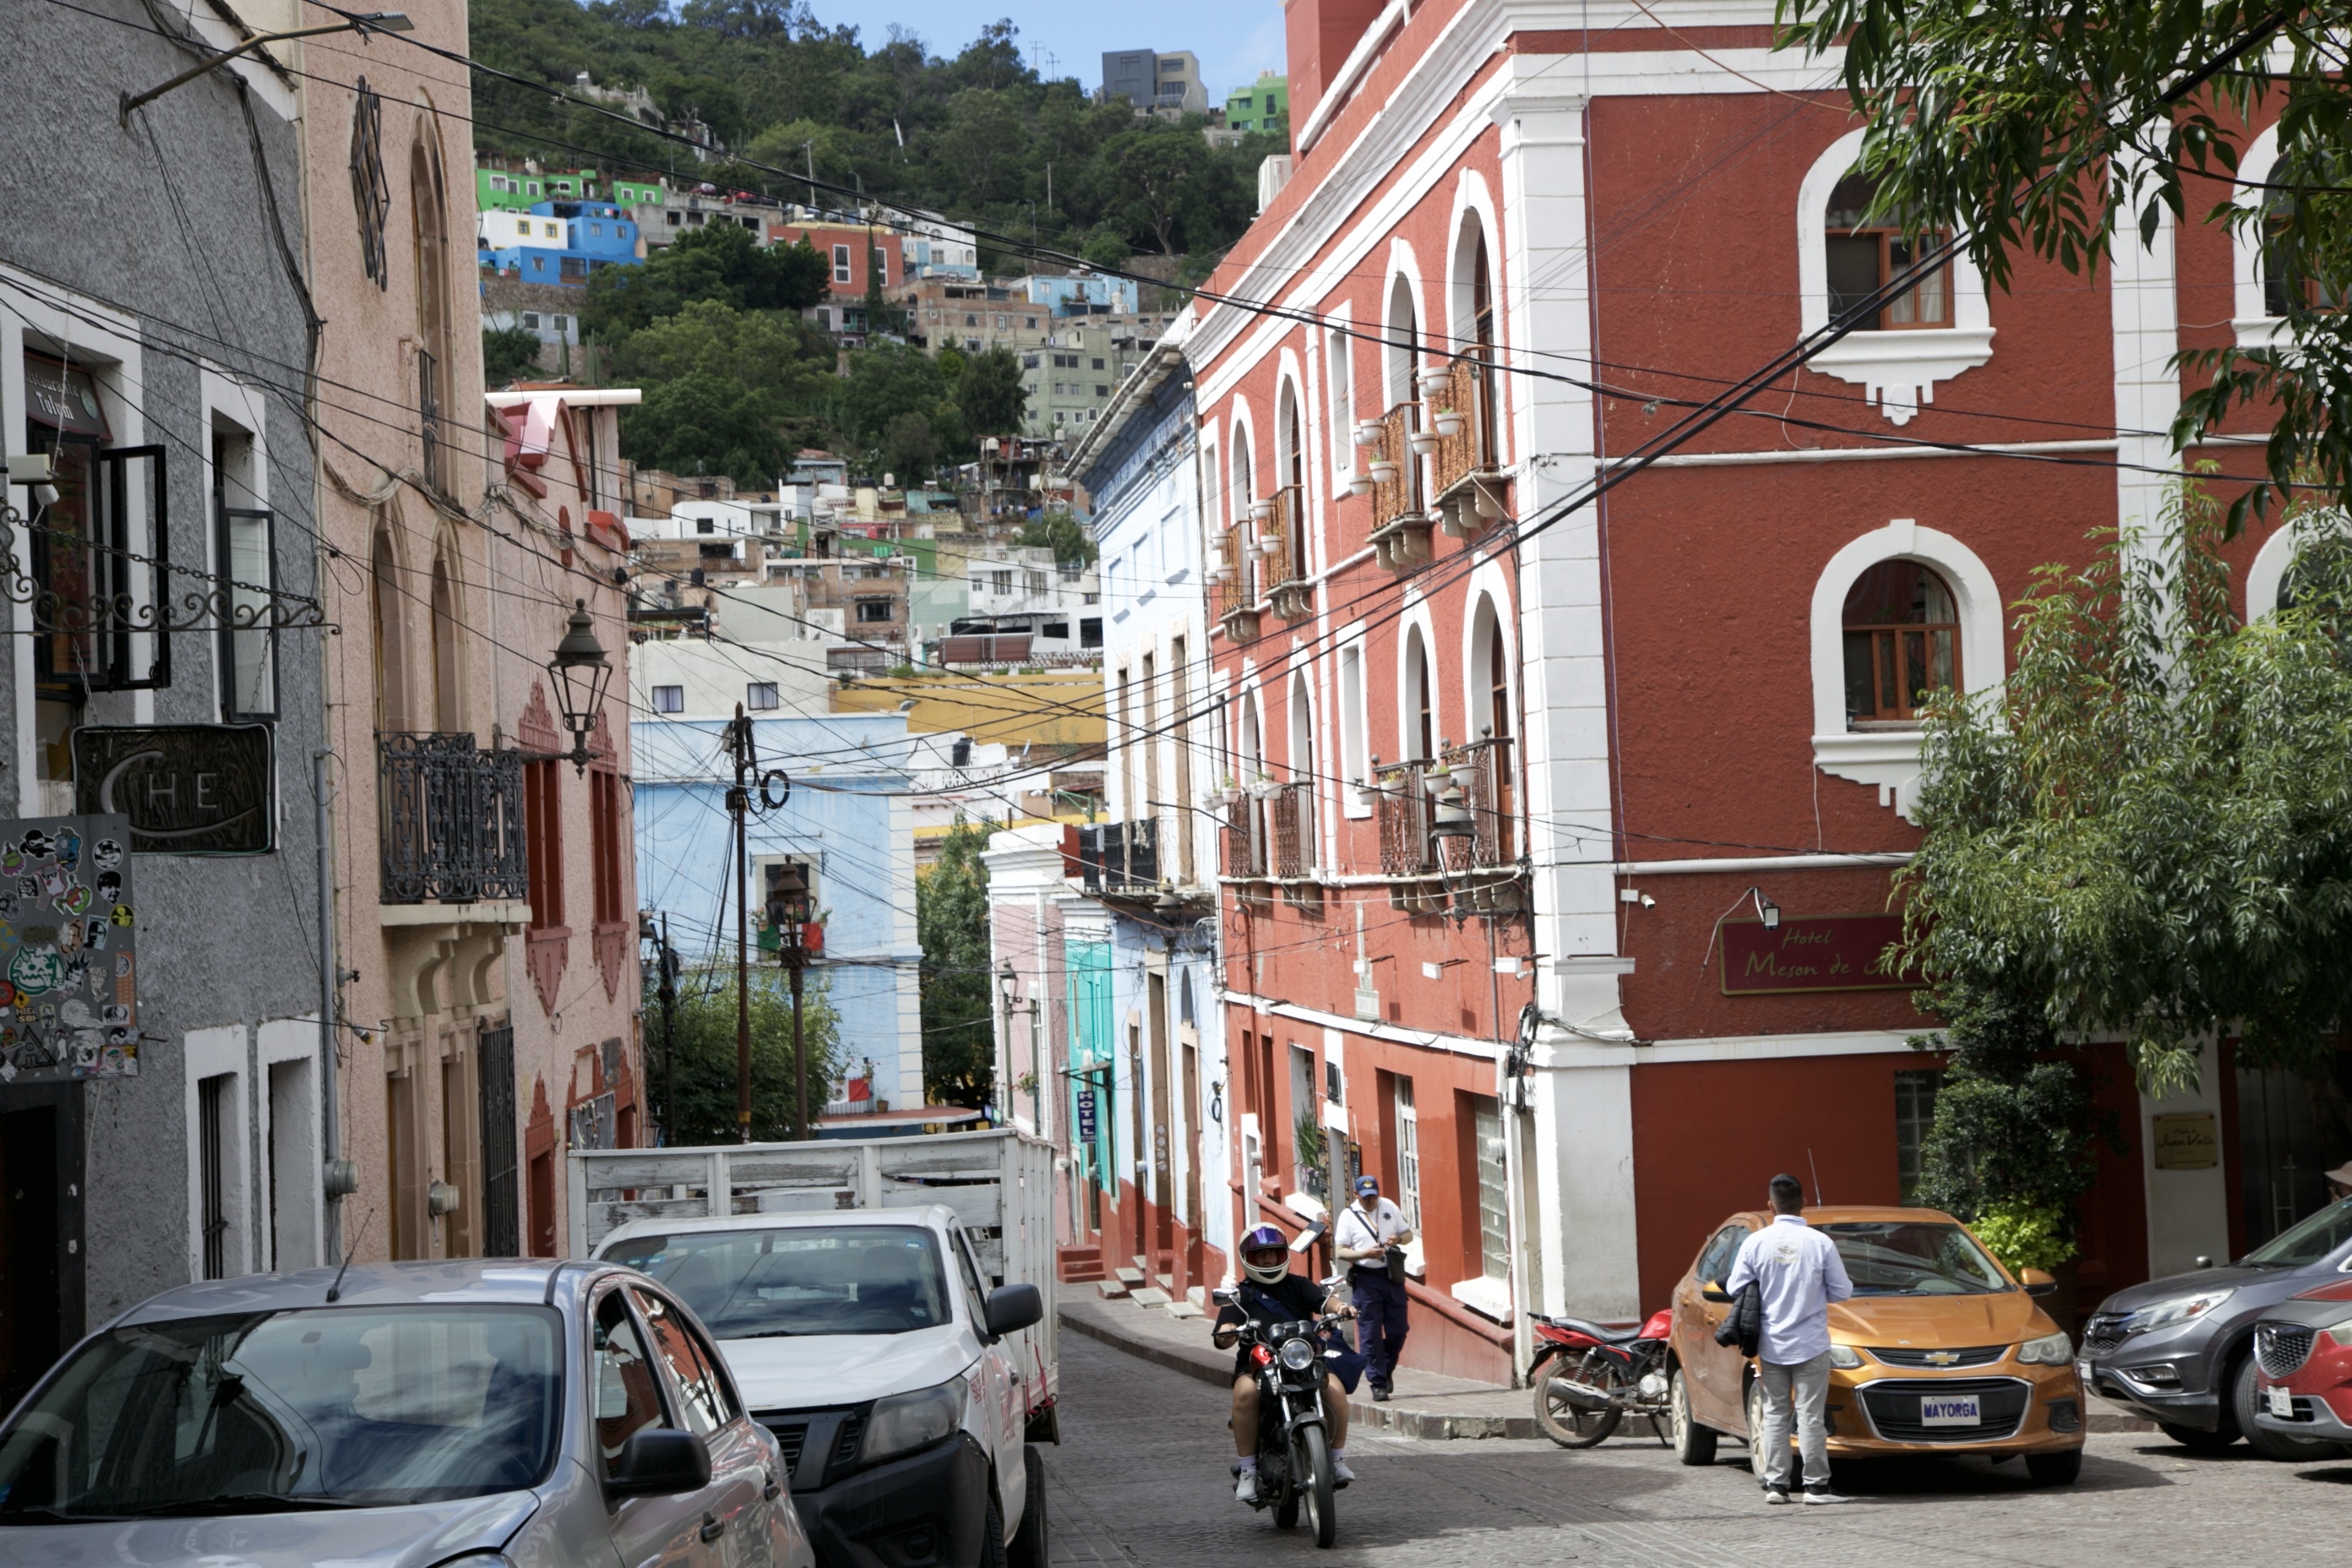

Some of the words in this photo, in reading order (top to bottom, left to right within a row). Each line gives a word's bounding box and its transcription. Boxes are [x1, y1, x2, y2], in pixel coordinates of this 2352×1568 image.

[35, 390, 74, 420] Tulum
[100, 750, 258, 837] CHE
[1781, 926, 1832, 950] Hotel
[1745, 950, 1819, 977] Meson
[1830, 953, 1851, 975] de
[1079, 1092, 1094, 1135] HOTEL
[1924, 1402, 1978, 1418] MAYORGA
